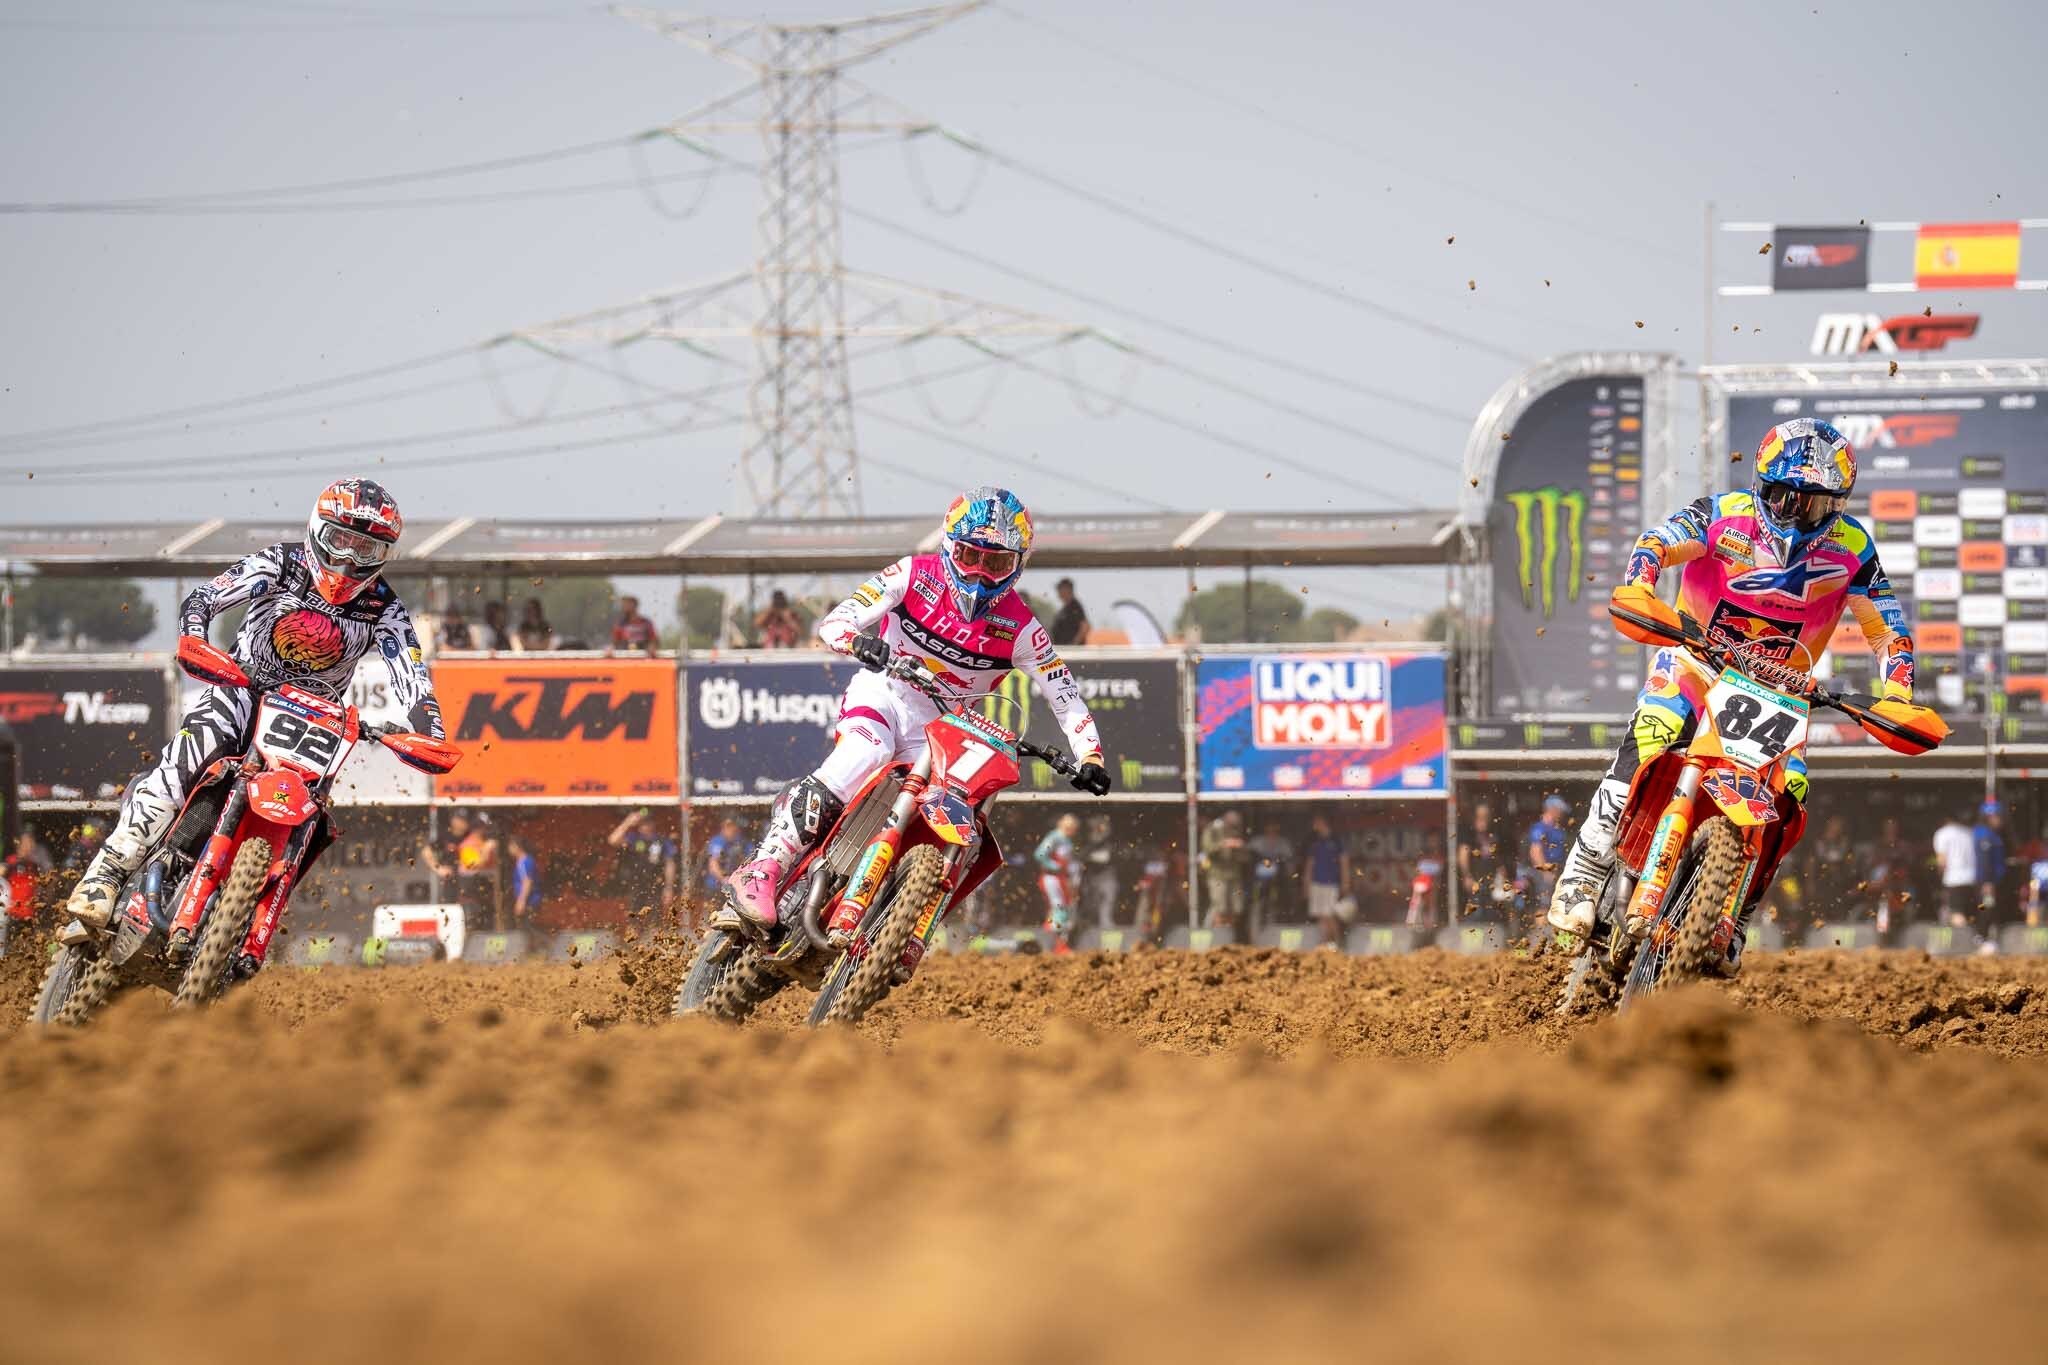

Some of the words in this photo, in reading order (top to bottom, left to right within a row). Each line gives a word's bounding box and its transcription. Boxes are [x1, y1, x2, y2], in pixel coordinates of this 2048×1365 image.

[1811, 313, 1979, 355] MXGP
[901, 618, 995, 669] GASGAS
[1750, 642, 1791, 660] Bull
[1260, 661, 1382, 700] LIQUI
[1735, 678, 1783, 705] MOTOREX
[266, 697, 309, 716] GUILLOD
[455, 675, 656, 741] KTM
[1261, 702, 1387, 743] MOLY
[1714, 694, 1799, 758] 84
[263, 713, 341, 767] 92
[946, 738, 997, 783] 1
[264, 878, 286, 926] DUNLOP
